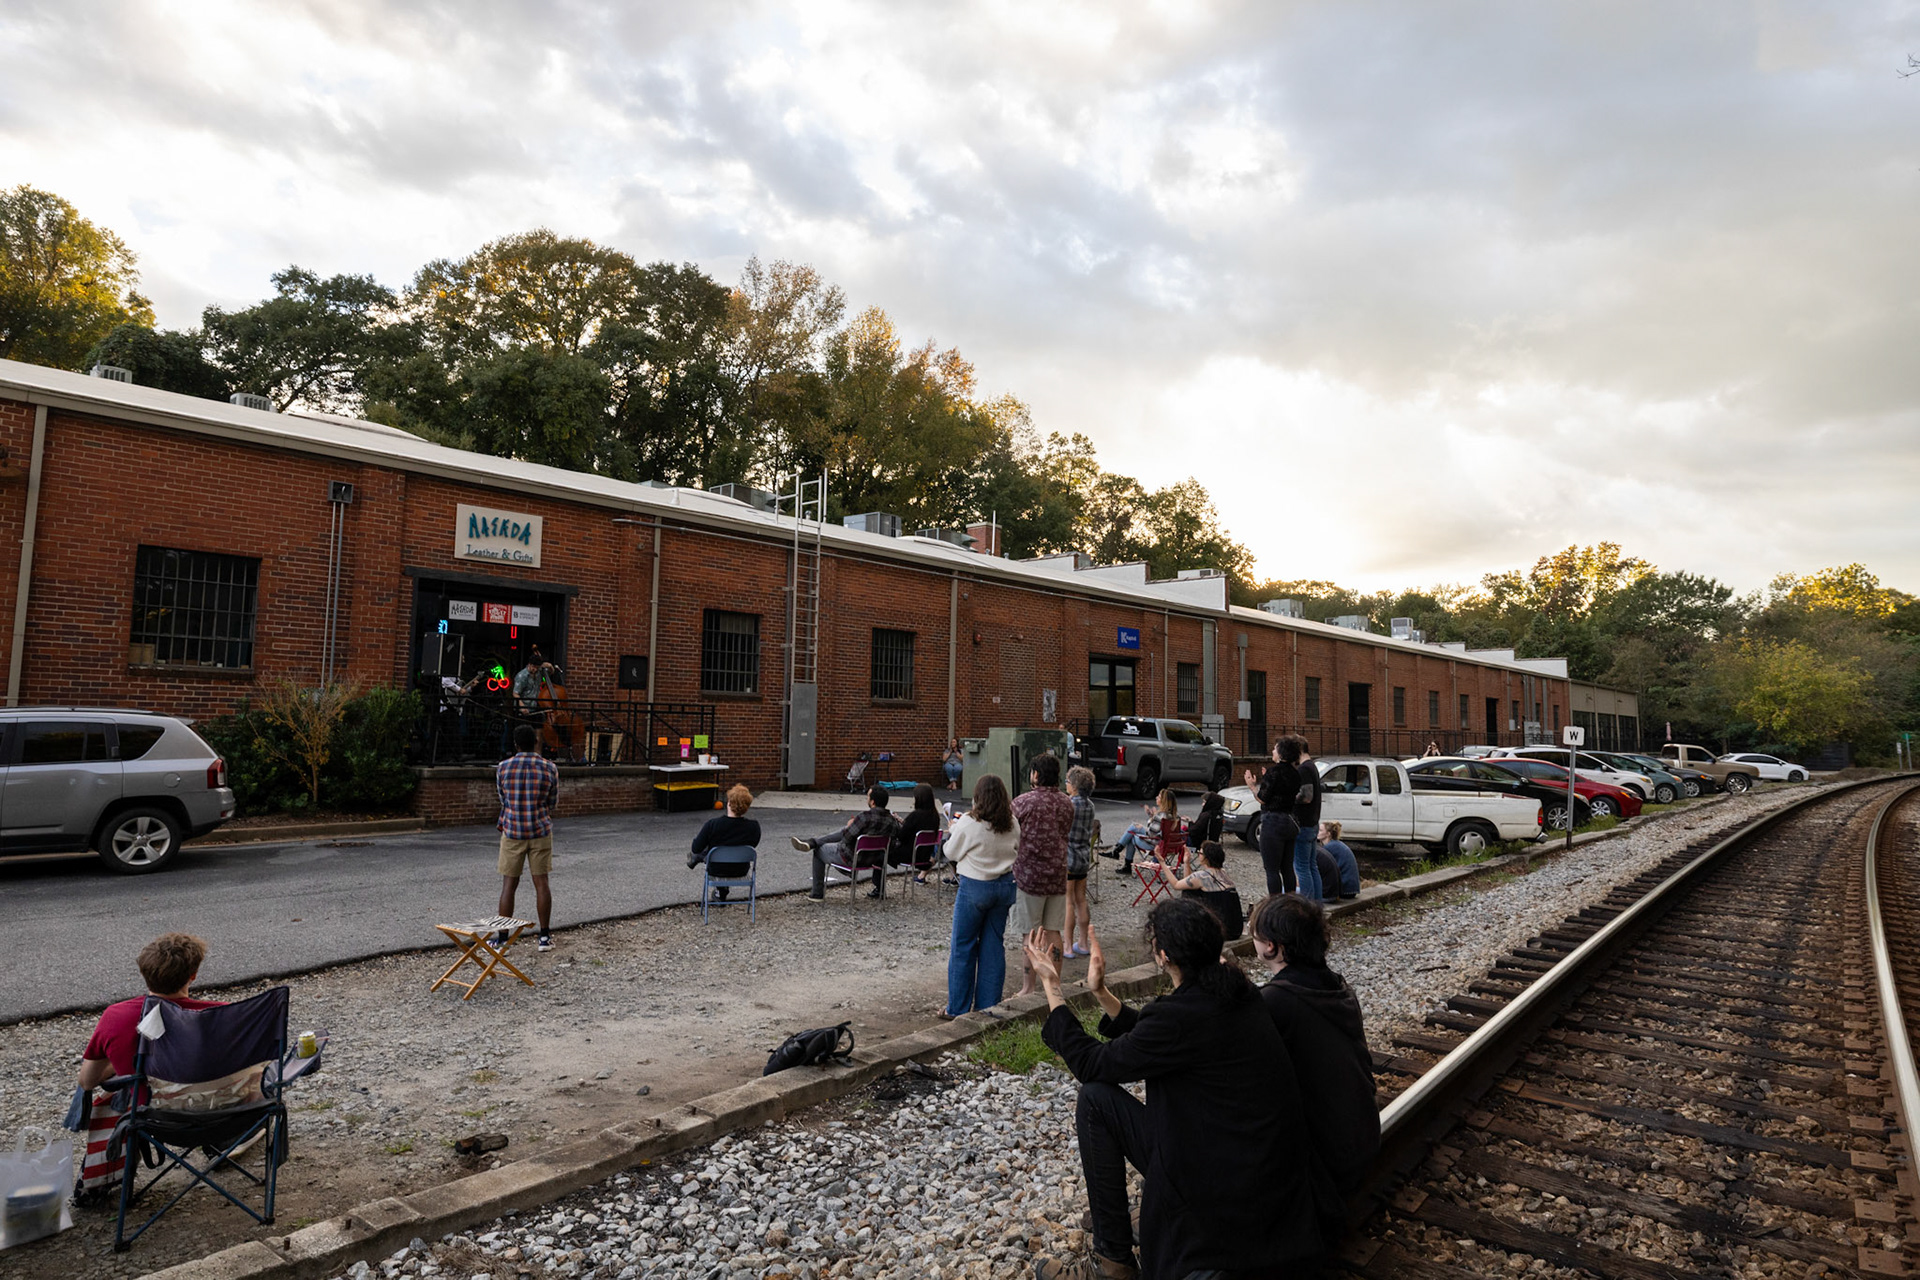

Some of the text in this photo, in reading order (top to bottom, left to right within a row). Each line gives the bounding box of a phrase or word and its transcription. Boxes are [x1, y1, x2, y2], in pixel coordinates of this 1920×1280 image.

[466, 544, 533, 563] Leather & Gifts
[1569, 731, 1579, 741] W
